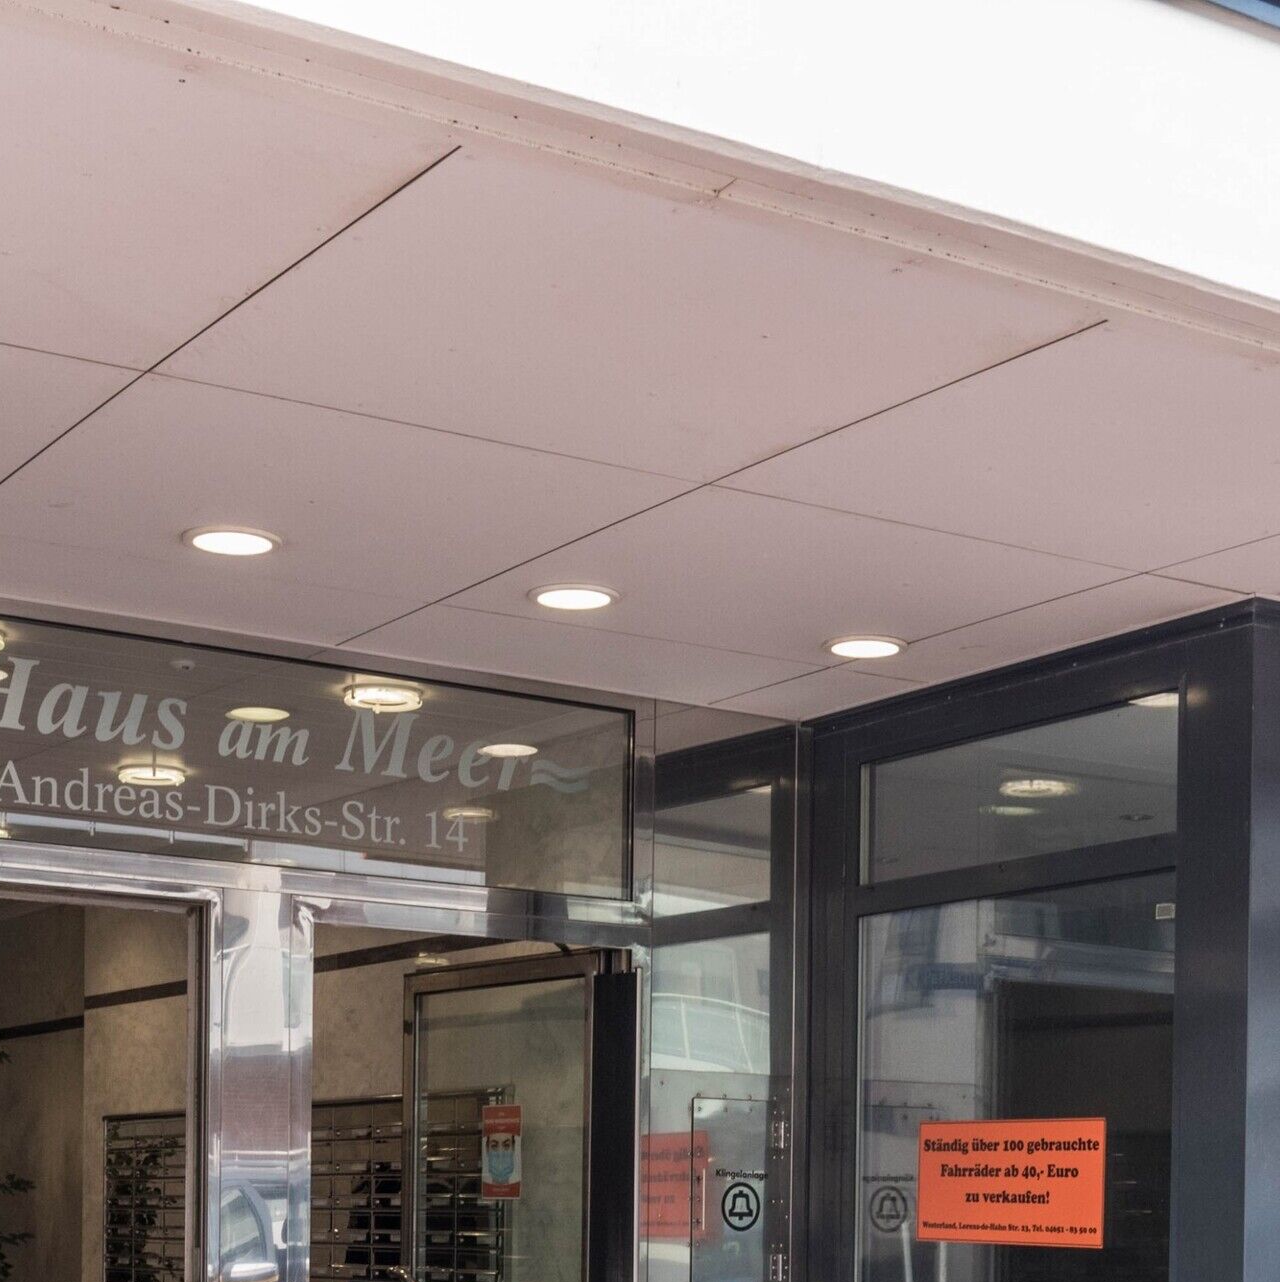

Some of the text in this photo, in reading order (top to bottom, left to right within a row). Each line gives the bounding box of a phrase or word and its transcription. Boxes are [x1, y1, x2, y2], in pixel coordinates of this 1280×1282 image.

[218, 717, 310, 767] am
[335, 708, 529, 791] Meer
[425, 810, 469, 852] 14
[924, 1137, 1100, 1155] Ständig über 100 gebrauchte
[715, 1168, 769, 1181] Klingelanlage
[940, 1163, 1001, 1178] Fahrräder
[1004, 1164, 1019, 1178] ab
[1047, 1164, 1079, 1178] Euro
[965, 1190, 1050, 1204] zu verkaufen!
[922, 1221, 958, 1230] Westerland,
[1008, 1223, 1020, 1232] Str.
[1032, 1224, 1044, 1232] Tel.
